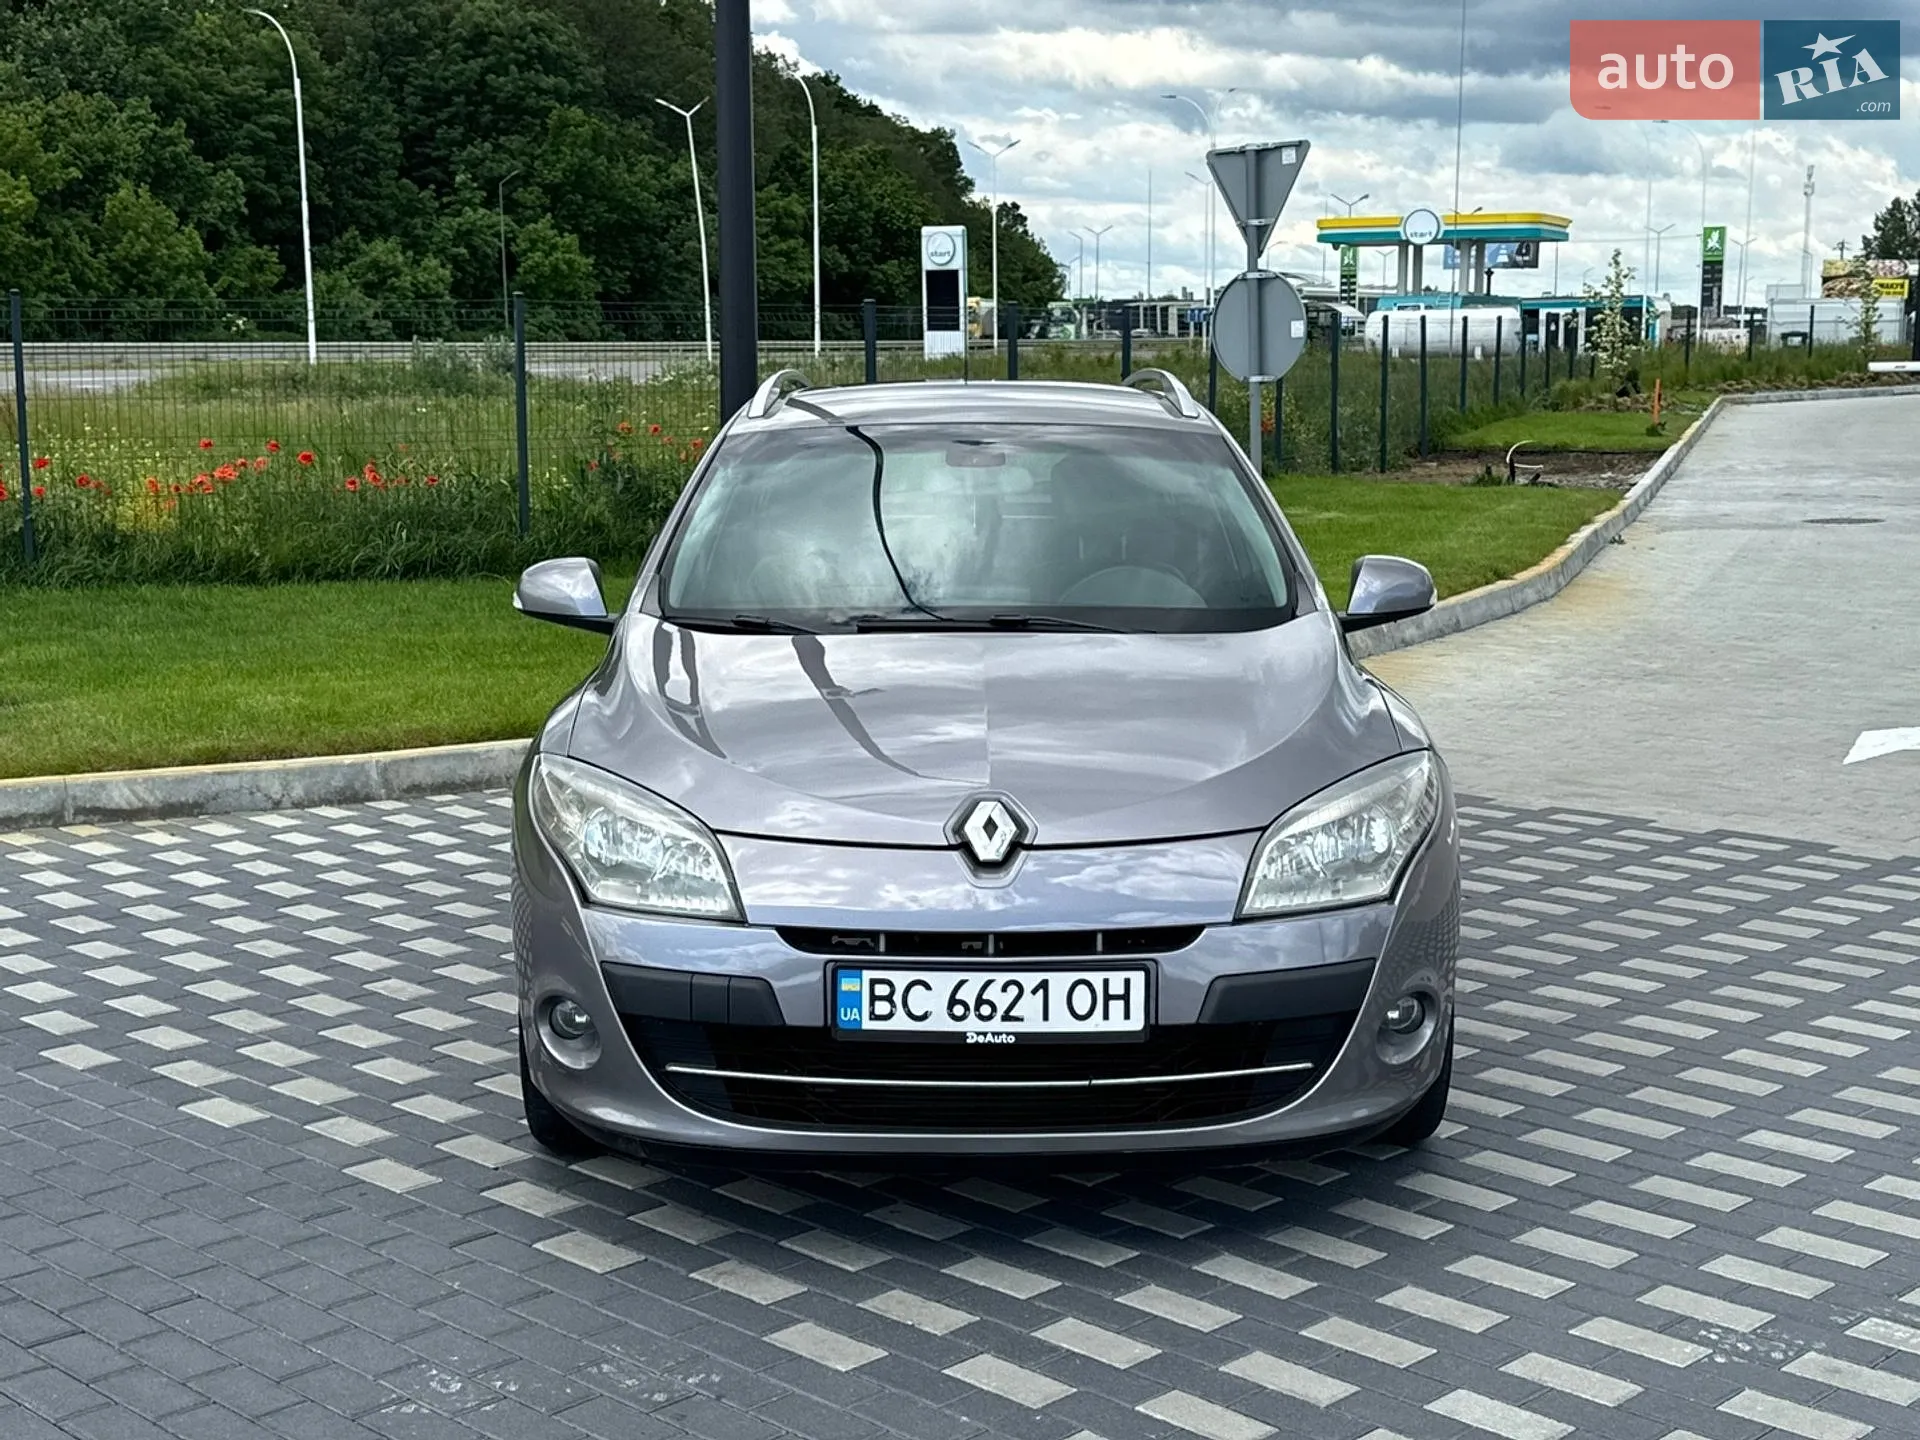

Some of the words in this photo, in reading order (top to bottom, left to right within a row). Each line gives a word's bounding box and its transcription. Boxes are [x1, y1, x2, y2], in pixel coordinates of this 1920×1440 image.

[1409, 230, 1433, 238] start
[868, 977, 933, 1022] BC
[946, 978, 1050, 1022] 6621
[1066, 977, 1131, 1022] OH
[840, 1007, 861, 1021] UA
[966, 1032, 1016, 1044] DeAuto
